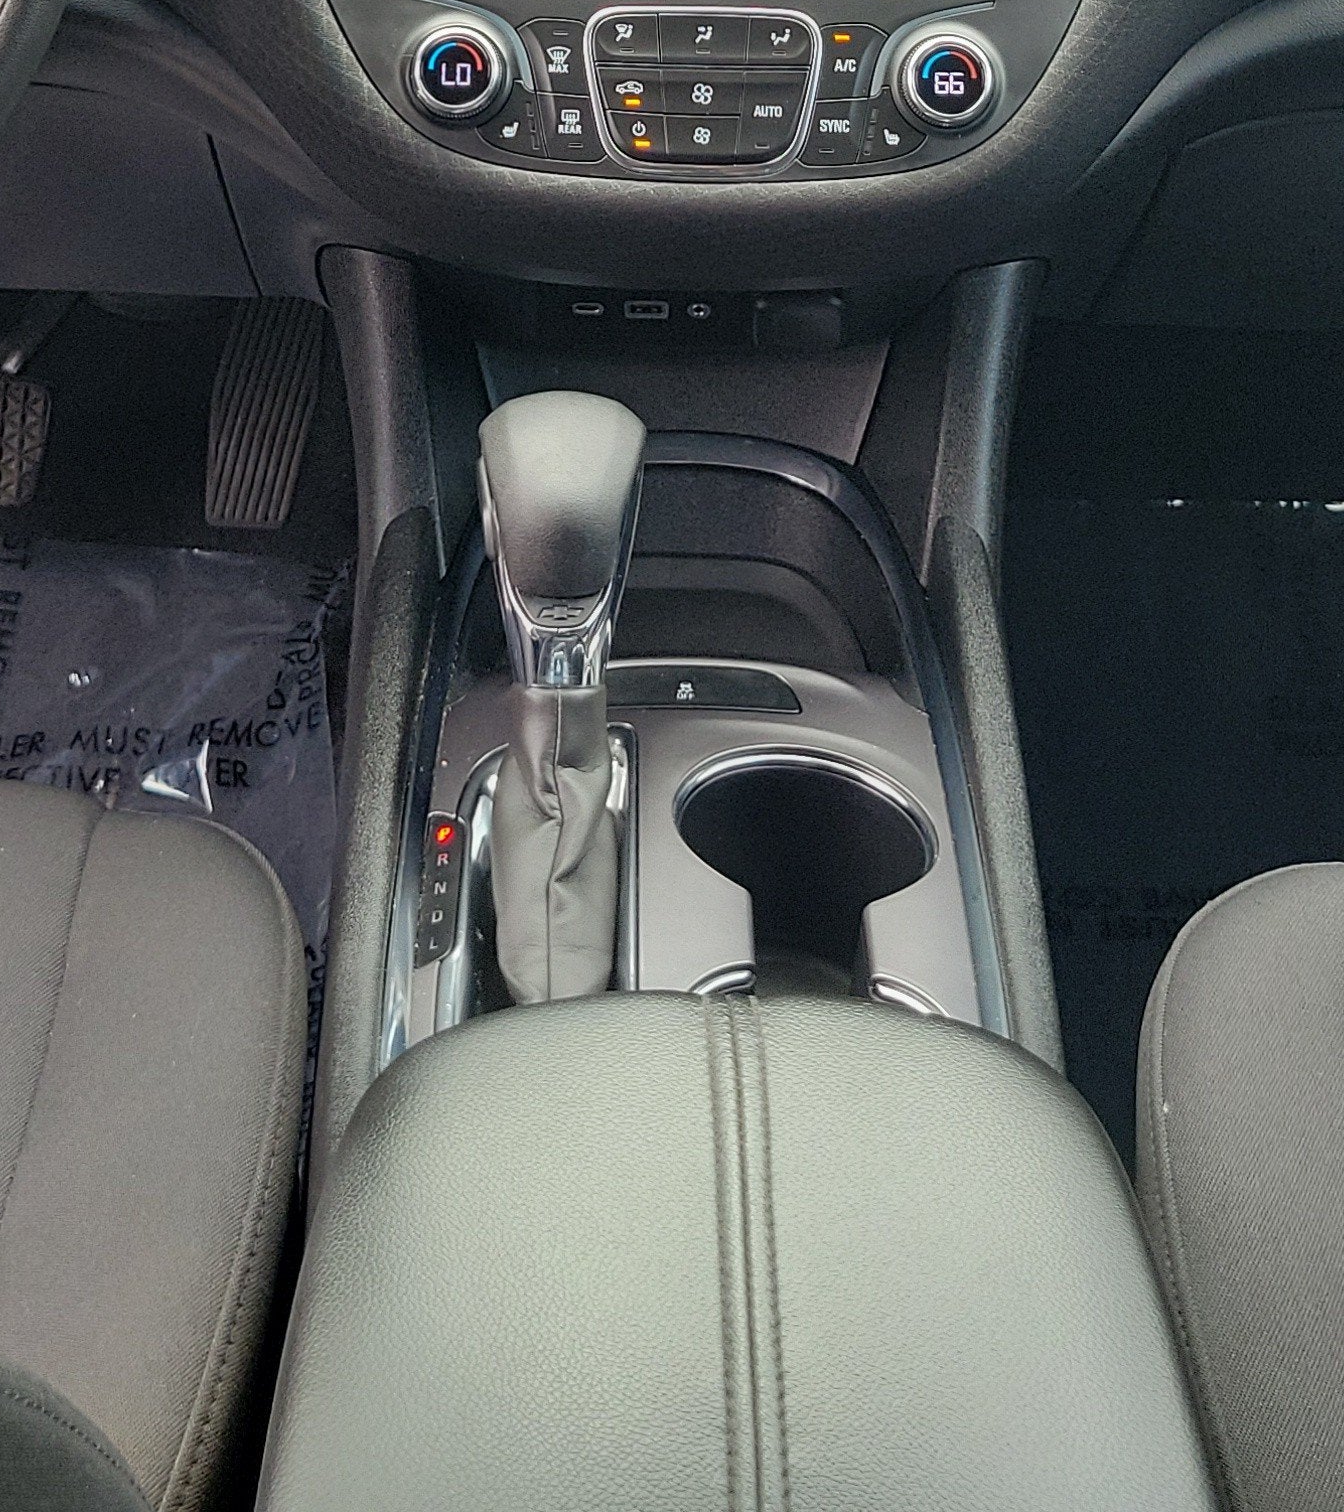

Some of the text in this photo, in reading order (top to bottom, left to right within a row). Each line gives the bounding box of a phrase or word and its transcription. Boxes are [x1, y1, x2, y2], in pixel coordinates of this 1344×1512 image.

[548, 62, 569, 74] MAX
[834, 58, 856, 74] A/C
[441, 63, 472, 86] LO
[934, 72, 966, 95] 66
[754, 105, 783, 119] AUTO
[558, 122, 582, 134] REAR
[820, 118, 850, 133] SYNC
[69, 724, 168, 757] MUST
[187, 701, 324, 748] REMOVE
[436, 825, 452, 842] P
[436, 853, 449, 867] R
[433, 881, 447, 895] N
[431, 909, 443, 923] D
[429, 936, 439, 950] L
